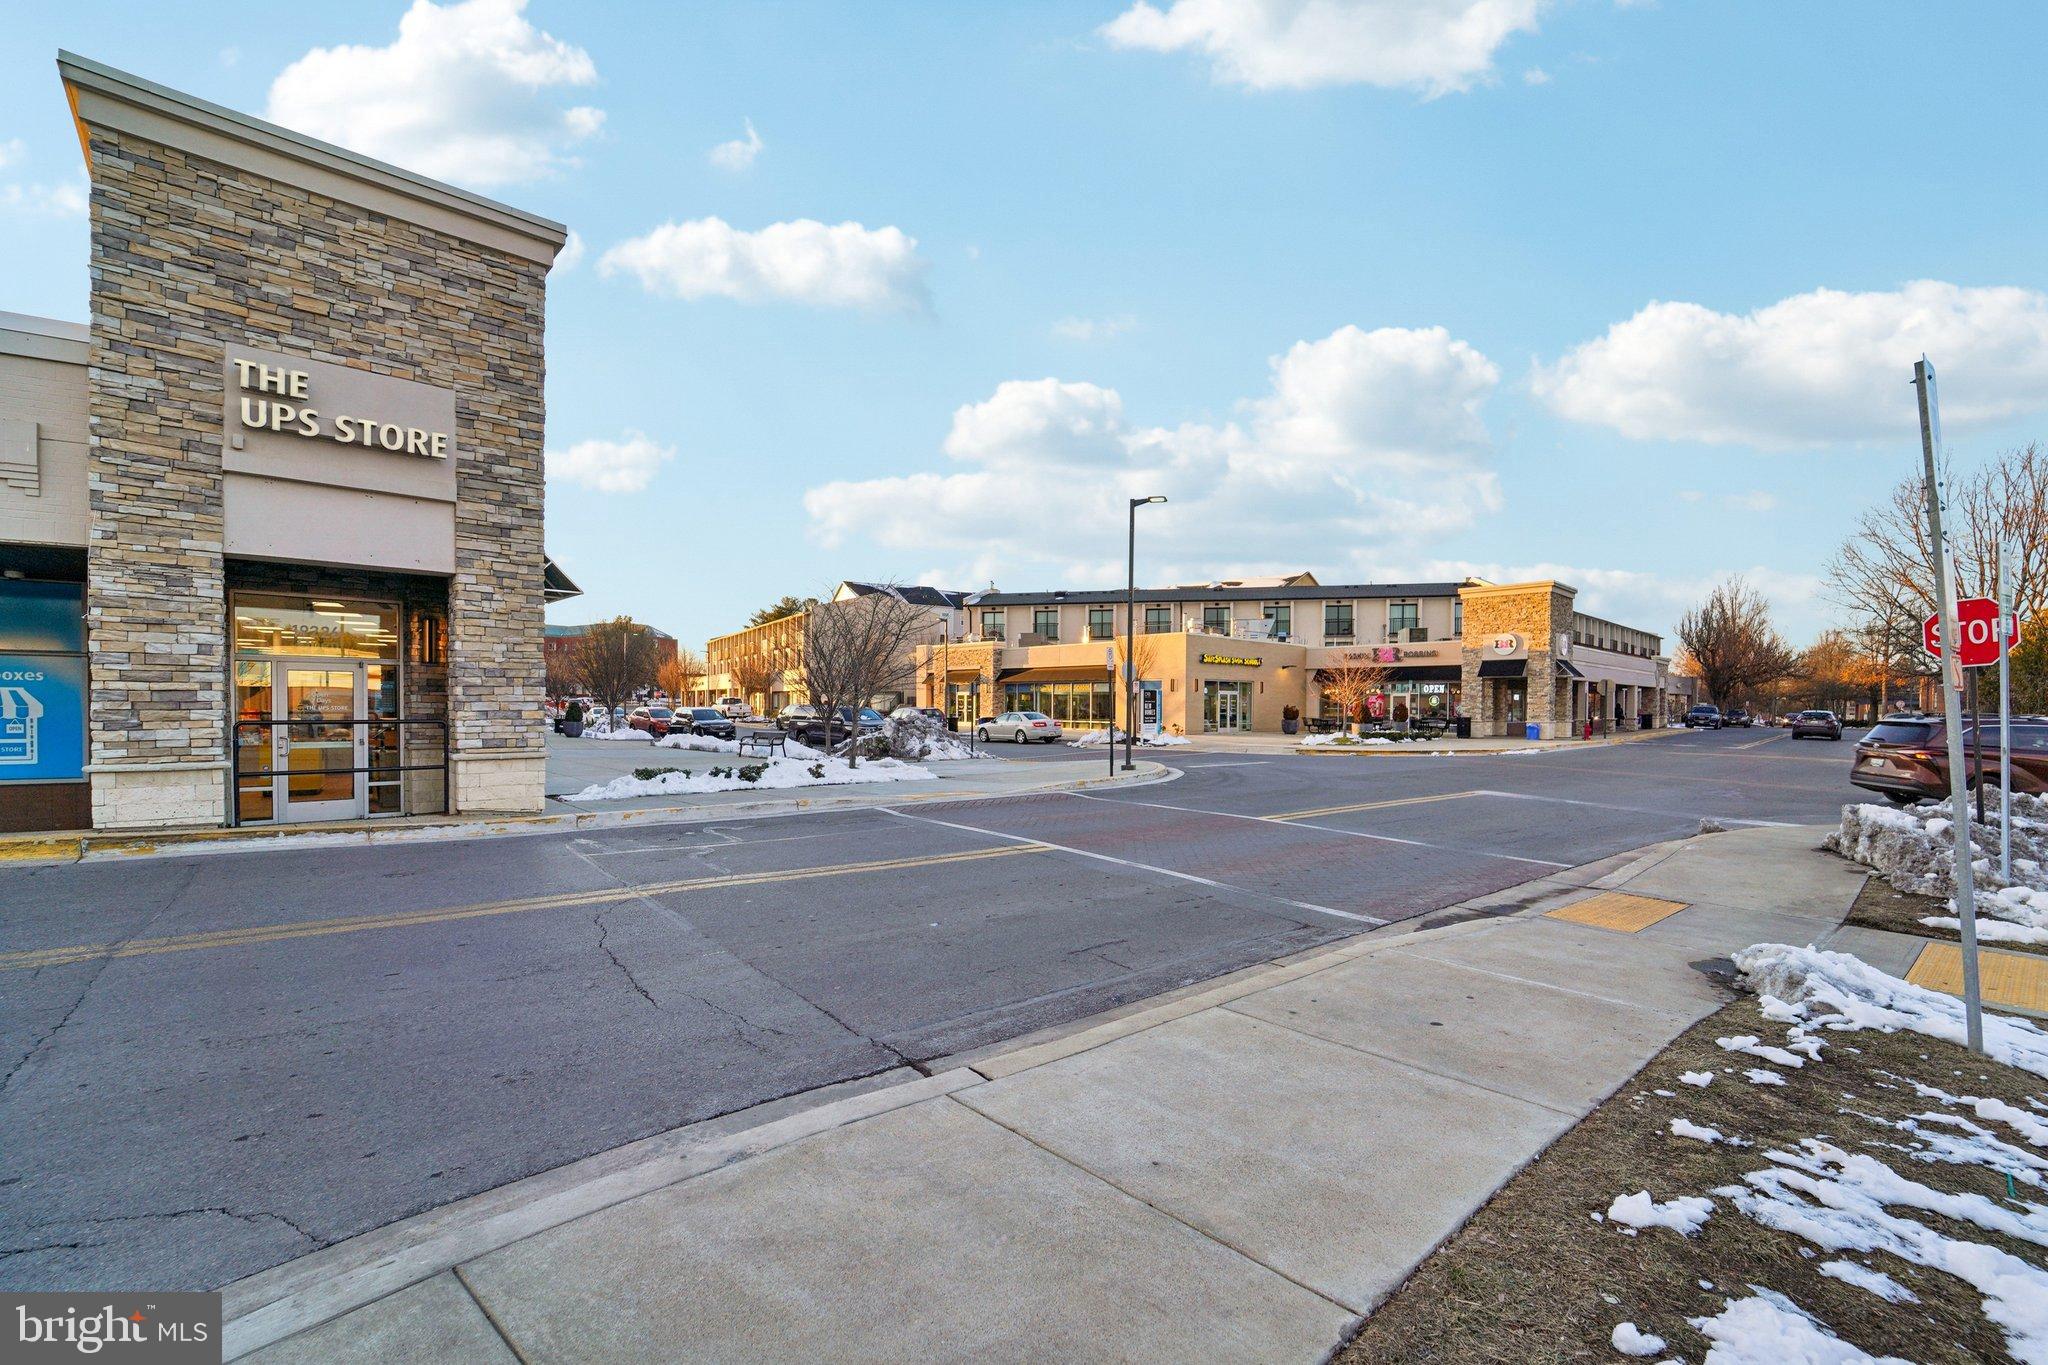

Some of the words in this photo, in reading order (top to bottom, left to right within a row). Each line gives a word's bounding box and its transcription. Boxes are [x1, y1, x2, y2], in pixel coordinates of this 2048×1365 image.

[234, 358, 309, 400] THE
[241, 397, 320, 437] UPS
[334, 415, 448, 459] STORE
[0, 671, 44, 681] oxes
[1423, 684, 1446, 694] OPEN
